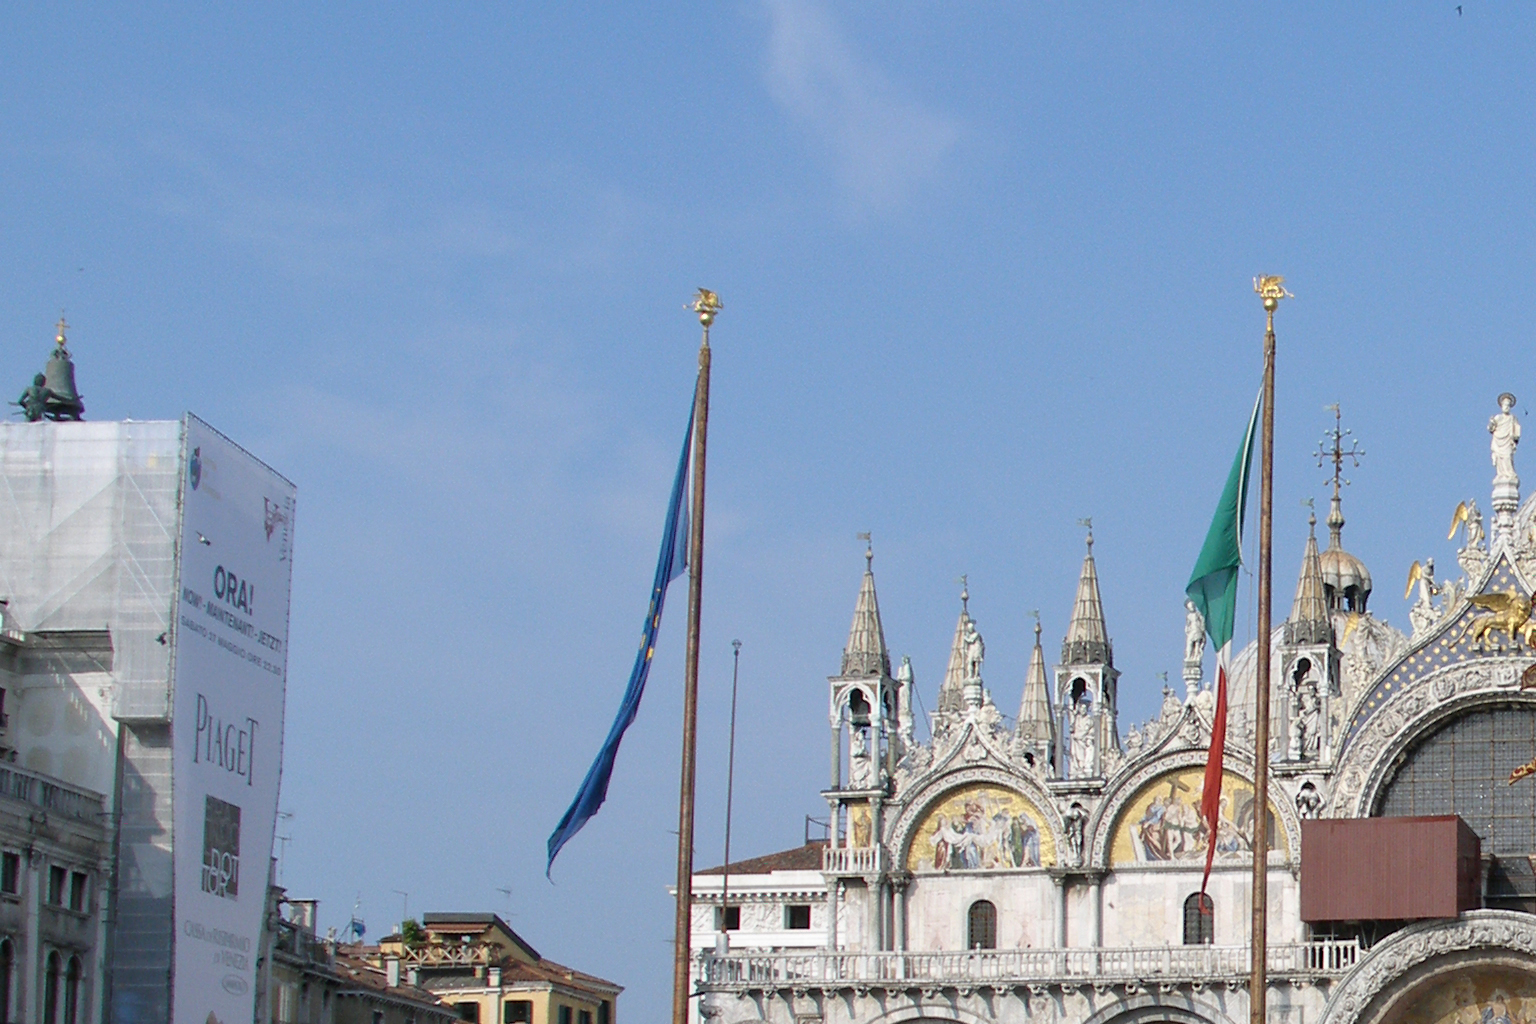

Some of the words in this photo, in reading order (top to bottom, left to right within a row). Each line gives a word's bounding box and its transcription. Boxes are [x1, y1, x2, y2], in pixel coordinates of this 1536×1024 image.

[213, 565, 254, 616] ORA!
[206, 600, 255, 639] MAINTENANT!
[257, 630, 282, 653] JETZT!
[193, 691, 260, 787] PIAGET
